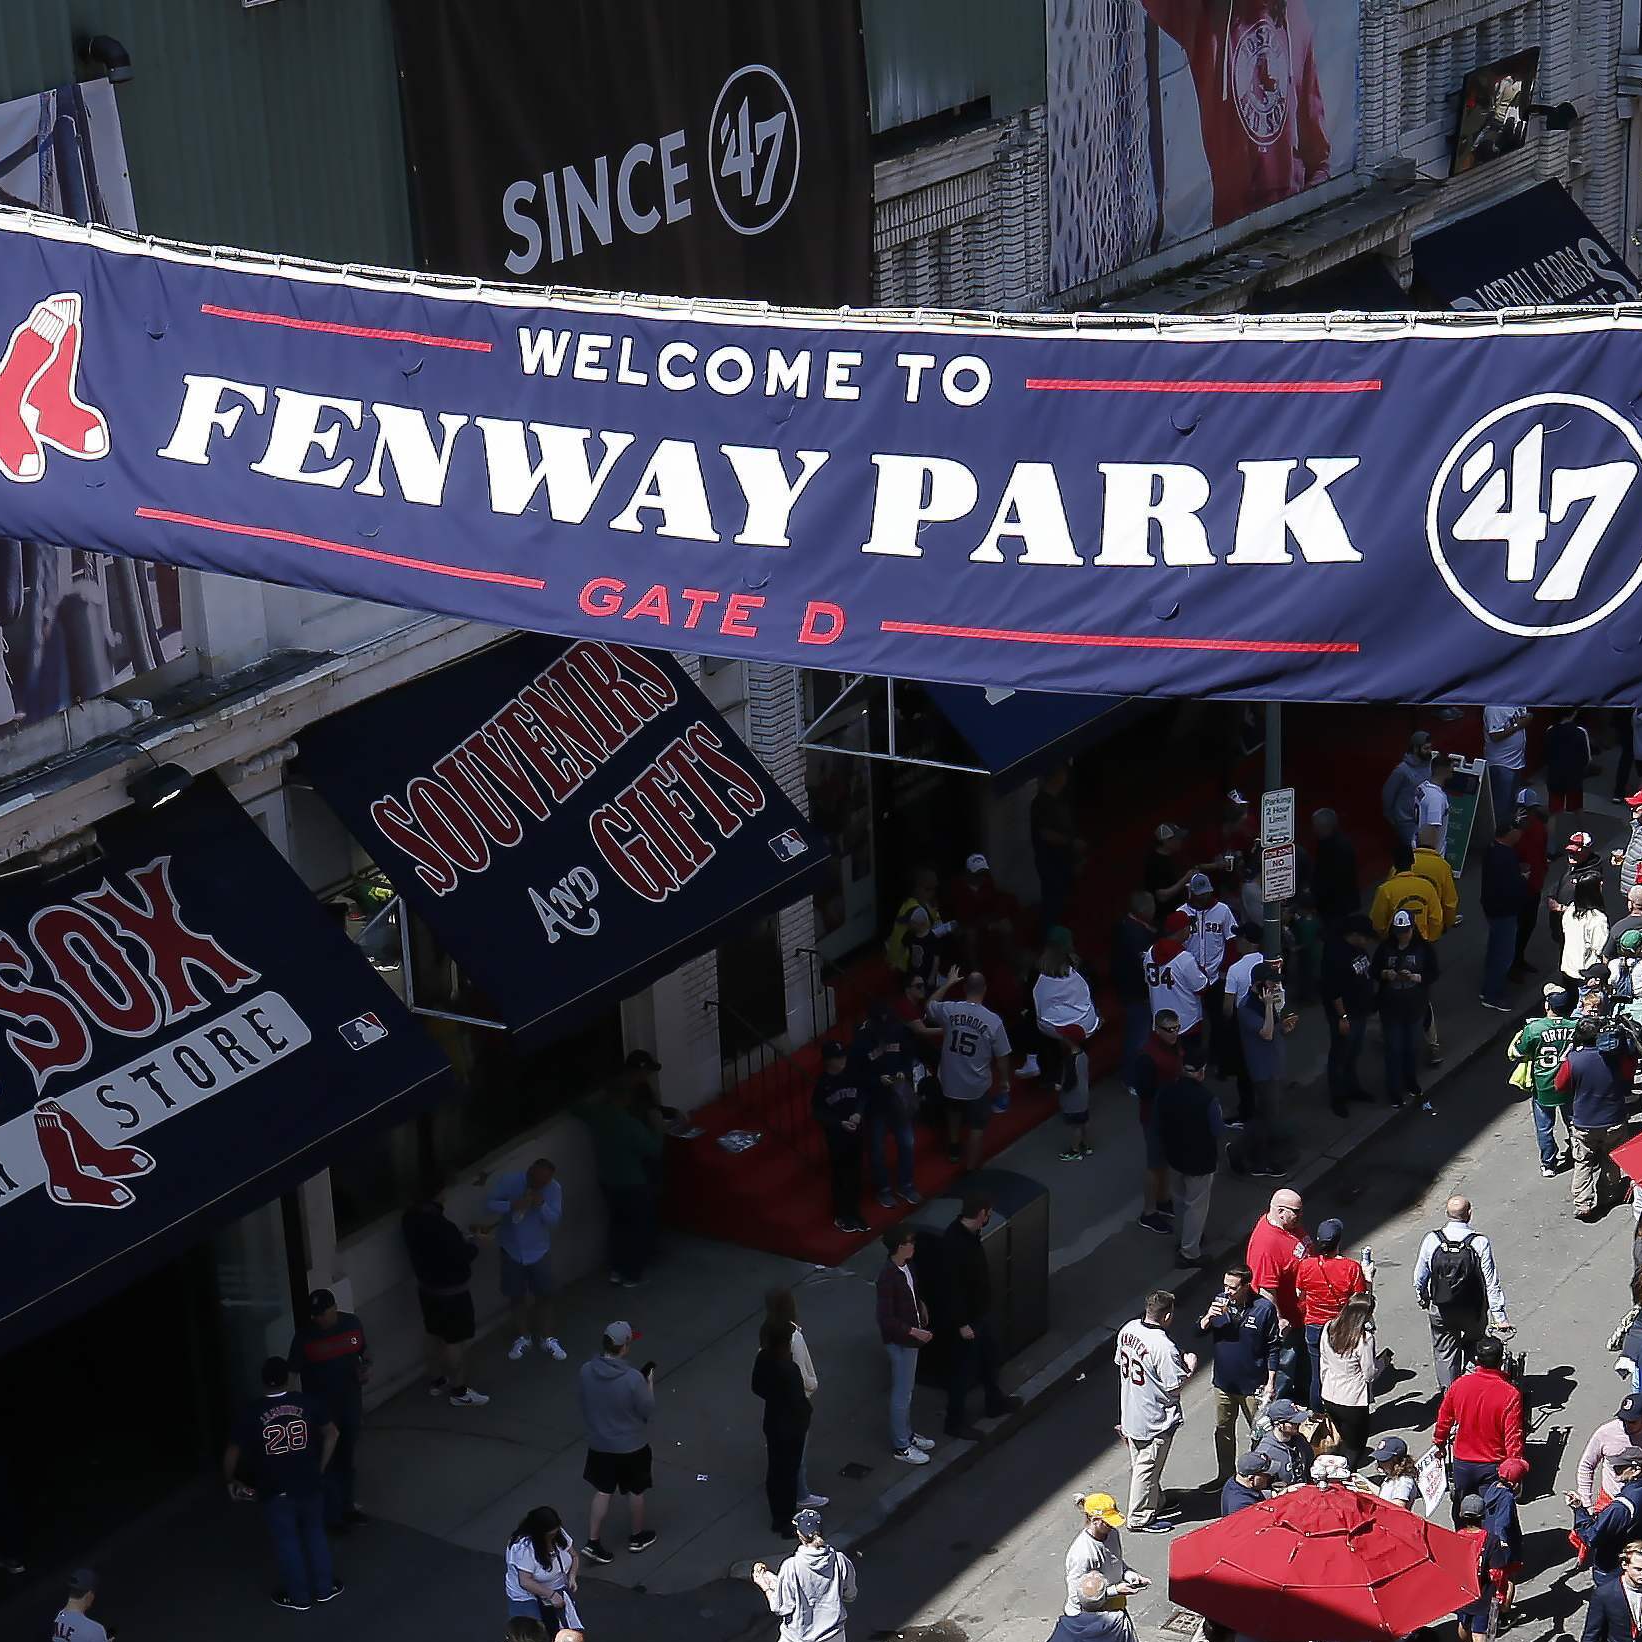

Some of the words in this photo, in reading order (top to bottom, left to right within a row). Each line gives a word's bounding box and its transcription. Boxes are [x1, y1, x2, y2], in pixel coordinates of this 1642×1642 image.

[502, 129, 693, 275] SINCE
[516, 326, 862, 402] WELCOME
[897, 352, 993, 408] TO
[155, 373, 830, 550] FENWAY
[860, 453, 1365, 568] PARK
[578, 577, 765, 640] GATE
[799, 601, 845, 647] D
[369, 637, 681, 898] SOUVENIRS
[1264, 795, 1292, 807] Parking
[1266, 807, 1271, 816] 2
[1272, 805, 1290, 816] Hour
[524, 863, 601, 947] AND
[588, 718, 767, 907] GIFTS
[1268, 815, 1287, 825] Limit
[1145, 964, 1175, 990] 34
[948, 1013, 987, 1037] PEDROIA
[948, 1029, 980, 1058] 15
[1541, 1027, 1575, 1043] ORTIZ
[107, 1003, 293, 1130] STORE
[1120, 1350, 1147, 1387] 33
[262, 1419, 308, 1456] 28
